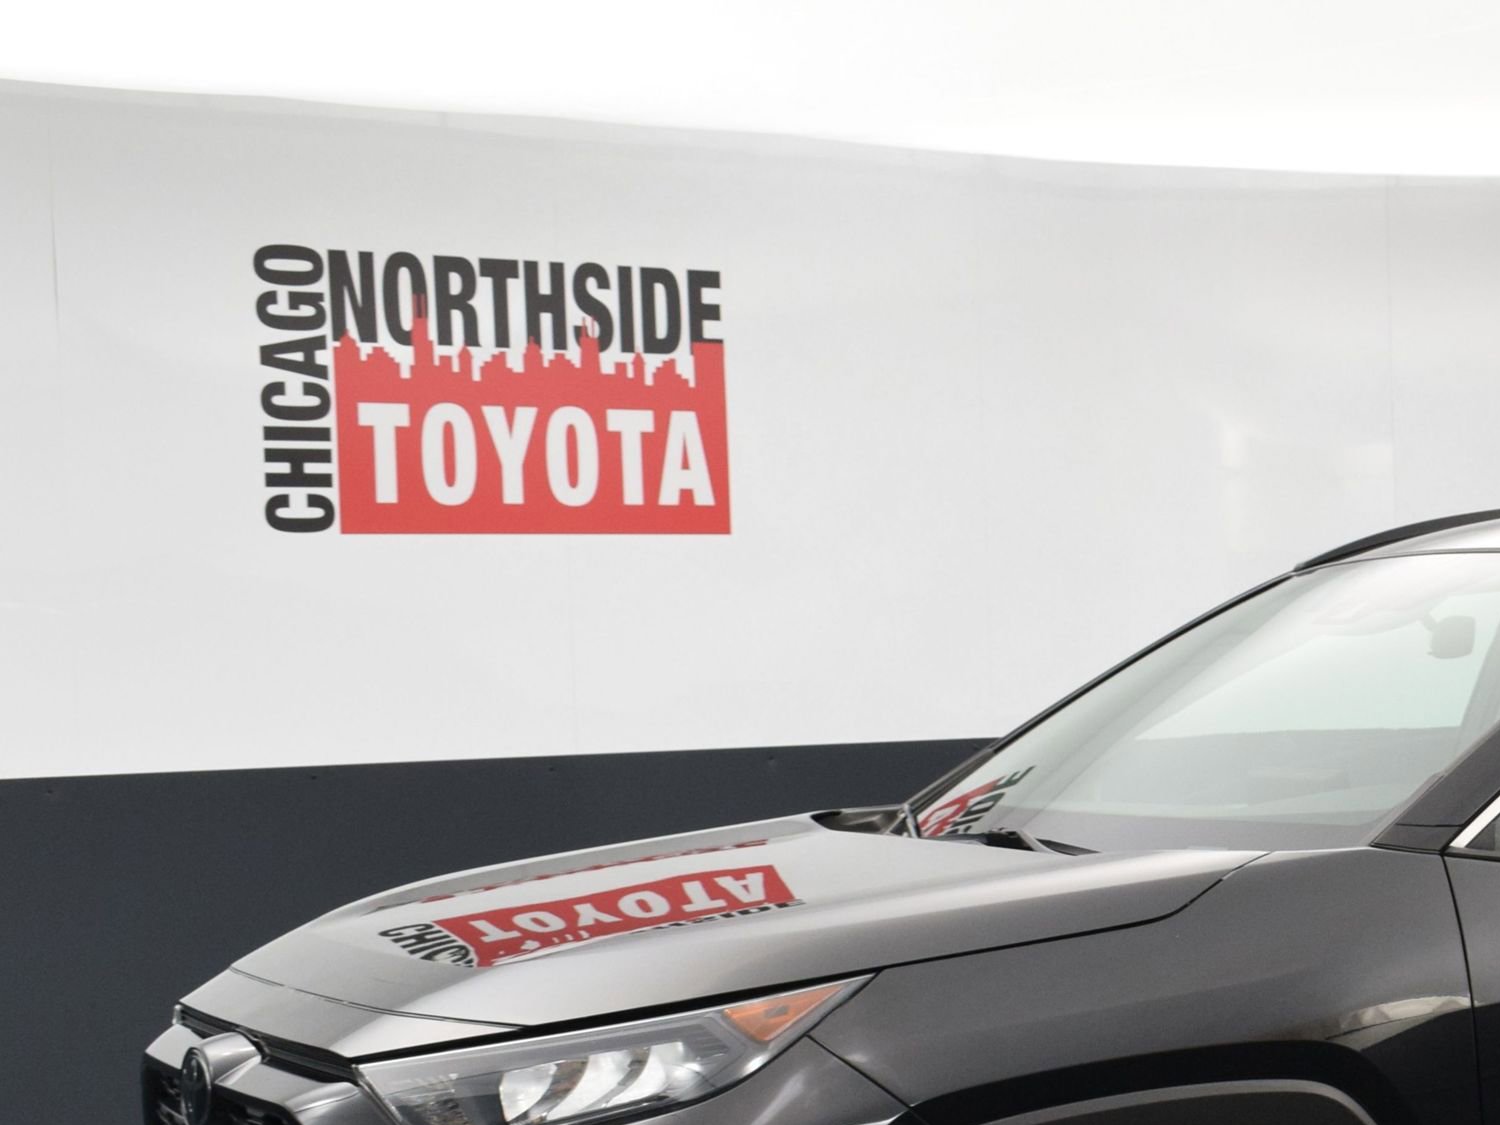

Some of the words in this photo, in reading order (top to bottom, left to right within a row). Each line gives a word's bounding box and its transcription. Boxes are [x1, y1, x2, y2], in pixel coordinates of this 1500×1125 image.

[327, 249, 723, 354] NORTHSIDE
[253, 244, 335, 533] CHICAGO
[357, 402, 716, 507] TOYOTA
